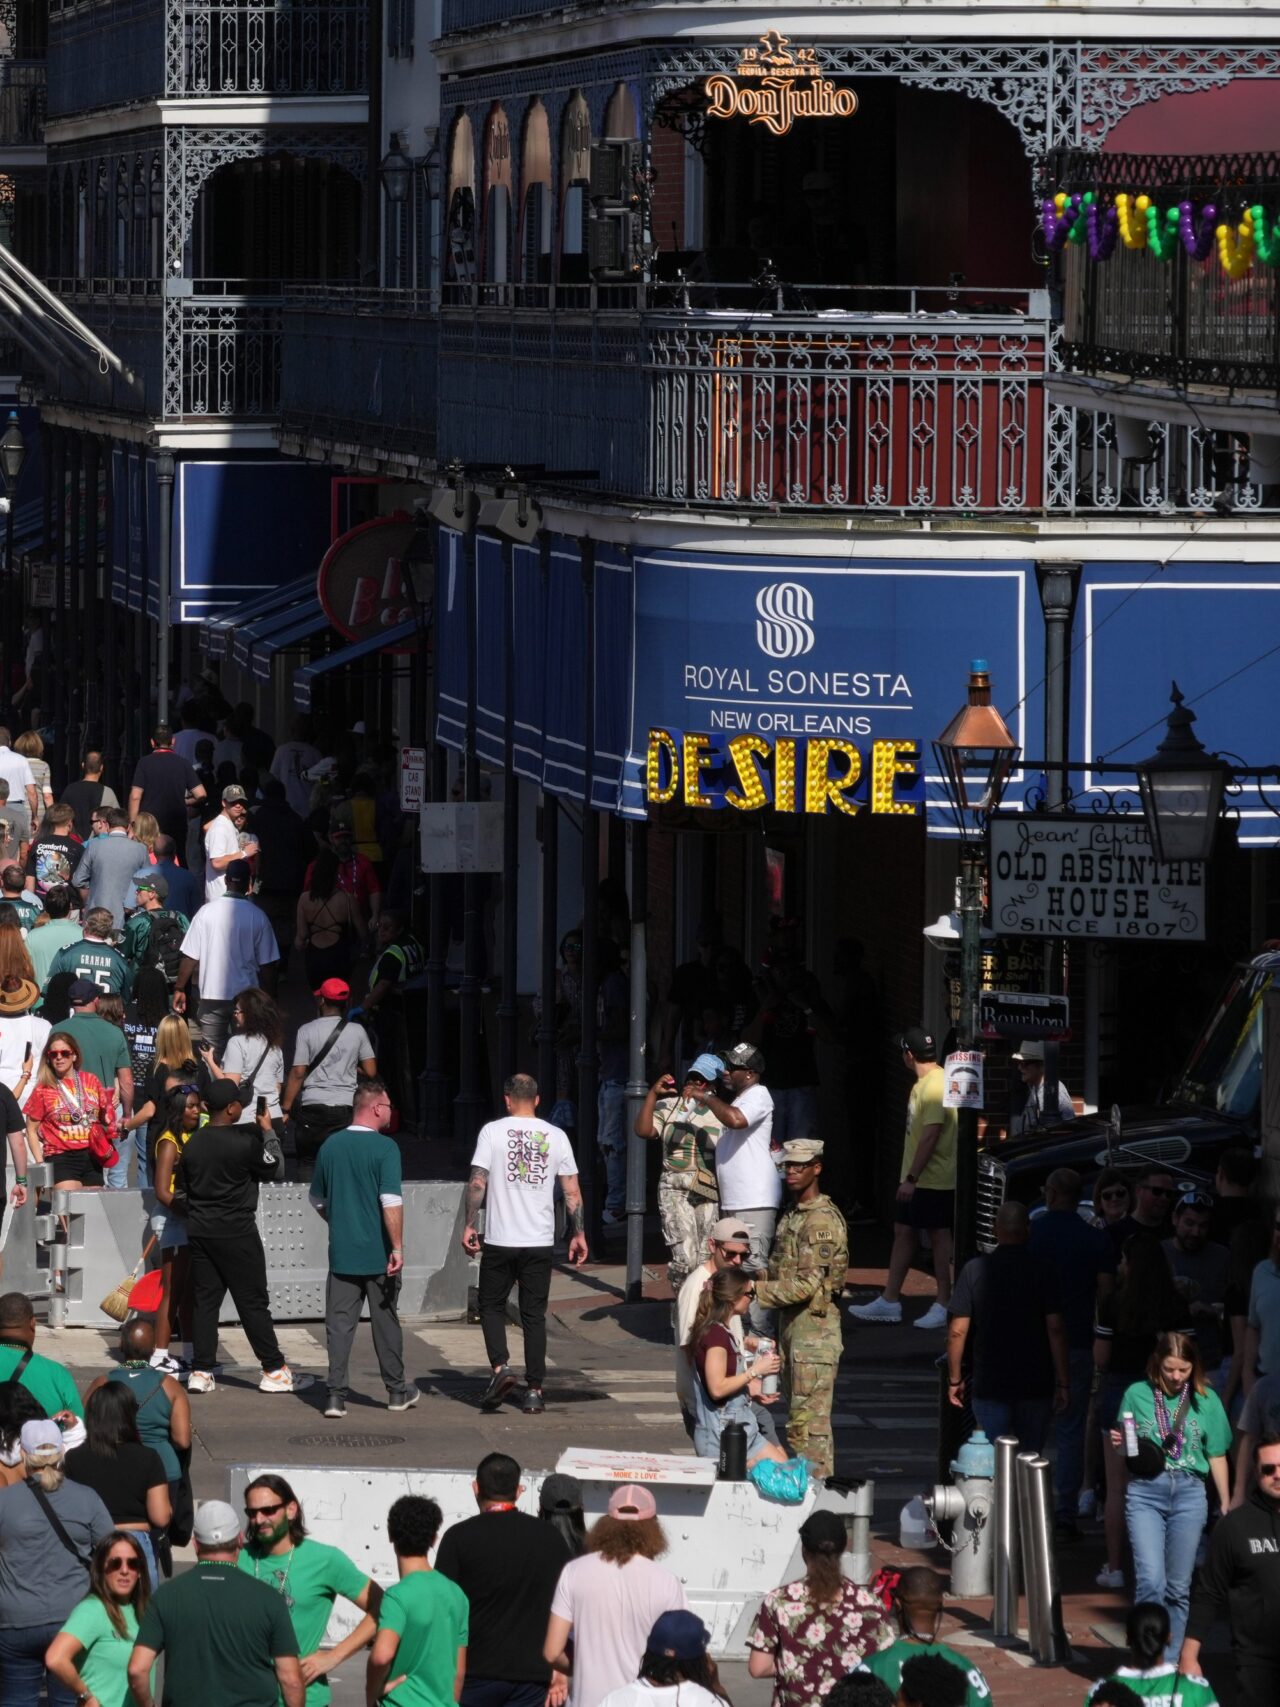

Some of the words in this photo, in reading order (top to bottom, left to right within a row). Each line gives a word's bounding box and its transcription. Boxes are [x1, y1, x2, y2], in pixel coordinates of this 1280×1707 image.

[743, 48, 757, 60] 19
[797, 48, 816, 61] 42
[684, 664, 759, 693] ROYAL
[768, 670, 912, 698] SONESTA
[710, 709, 752, 730] NEW
[757, 713, 872, 735] ORLEANS
[408, 772, 419, 782] CAB
[647, 727, 921, 816] DESIRE
[404, 785, 422, 797] STAND
[996, 851, 1048, 881] OLD
[1060, 853, 1202, 886] ABSINTHE
[1047, 886, 1150, 919] HOUSE
[1020, 917, 1099, 934] SINCE
[1116, 921, 1178, 936] 1807
[80, 954, 112, 967] GRAHAM
[949, 1052, 981, 1063] MISSING
[613, 1471, 632, 1479] MORE
[640, 1472, 658, 1480] LOVE
